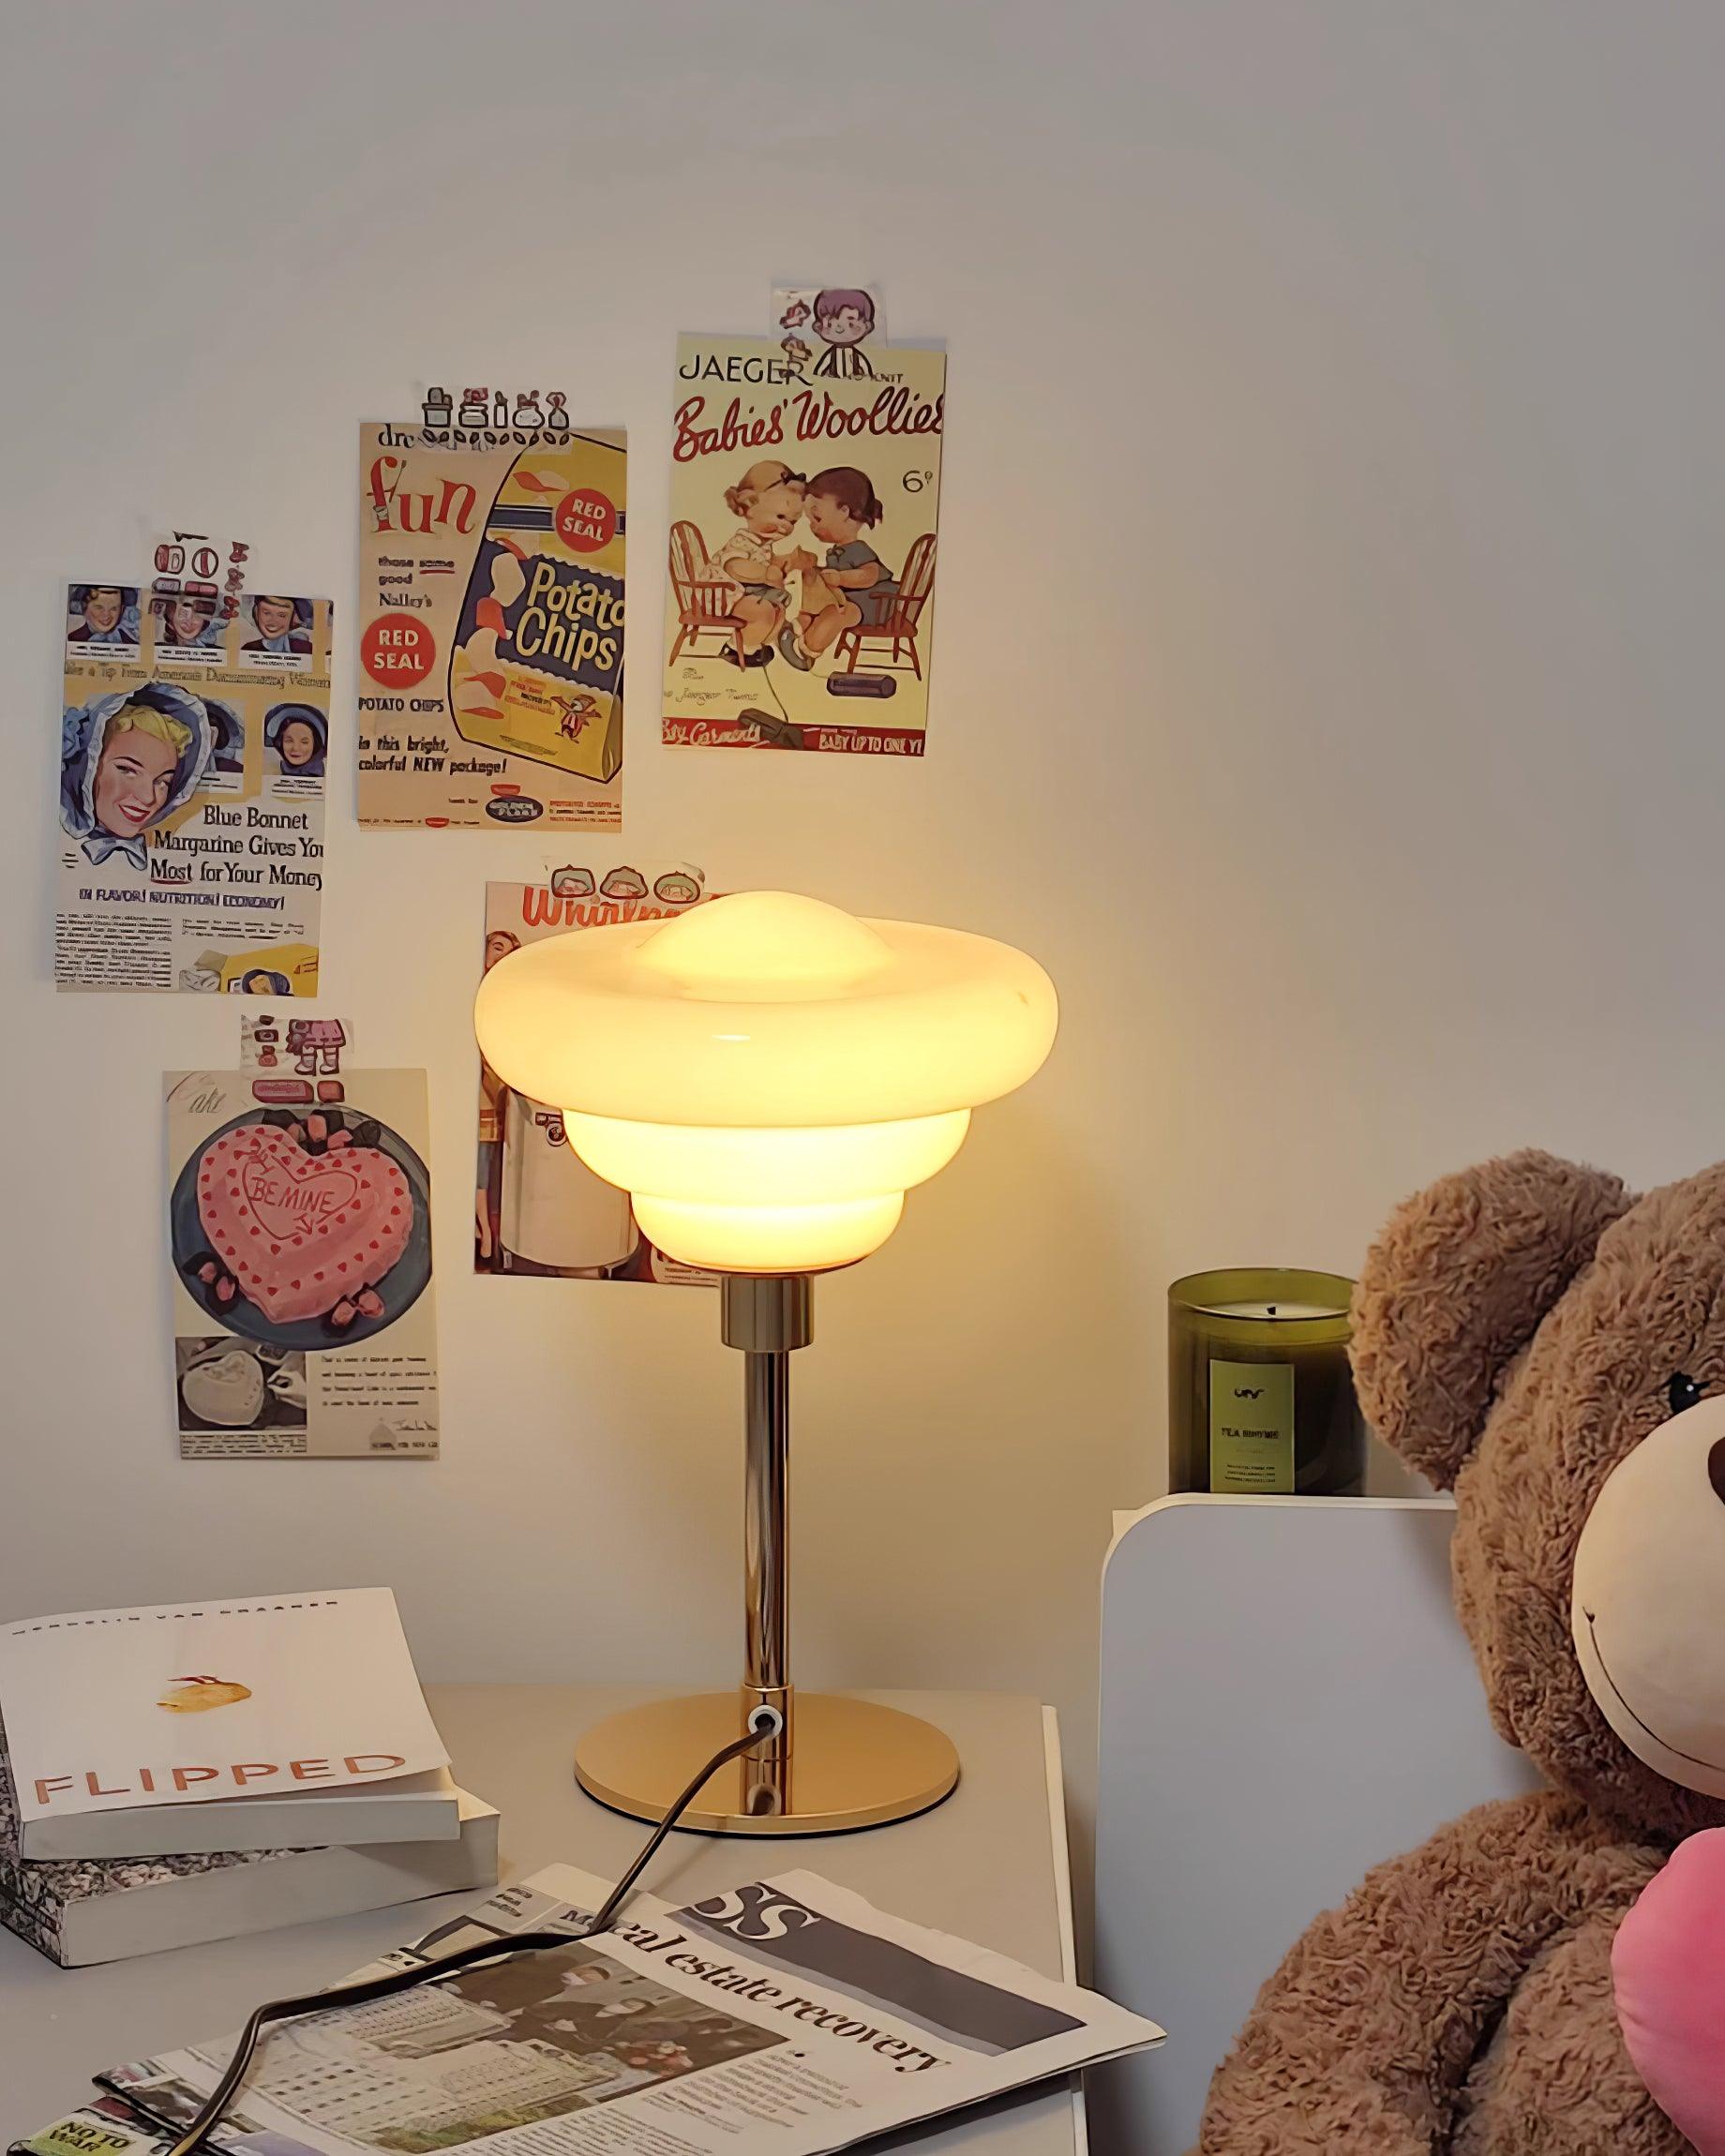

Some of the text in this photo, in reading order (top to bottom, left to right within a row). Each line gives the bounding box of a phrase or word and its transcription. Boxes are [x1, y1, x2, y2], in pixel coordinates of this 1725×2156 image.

[679, 354, 813, 386] JAEGER
[672, 396, 788, 463] Babies'
[367, 457, 480, 534] fun
[573, 499, 607, 521] RED
[562, 517, 605, 543] SEAL
[379, 629, 419, 647] RED
[517, 606, 617, 672] Chips
[374, 652, 425, 671] SEAL
[358, 696, 405, 712] POTATO
[412, 757, 445, 772] NEW
[203, 804, 308, 831] Blue Bonnet
[153, 830, 244, 859] Margarine
[248, 835, 296, 857] Gives
[150, 859, 322, 891] Most for Your Money
[250, 1175, 336, 1214] BE MINE
[35, 1754, 406, 1804] FLIPPED
[665, 1953, 783, 2003] estate
[772, 1996, 952, 2074] recovery
[60, 2120, 130, 2149] NO TO
